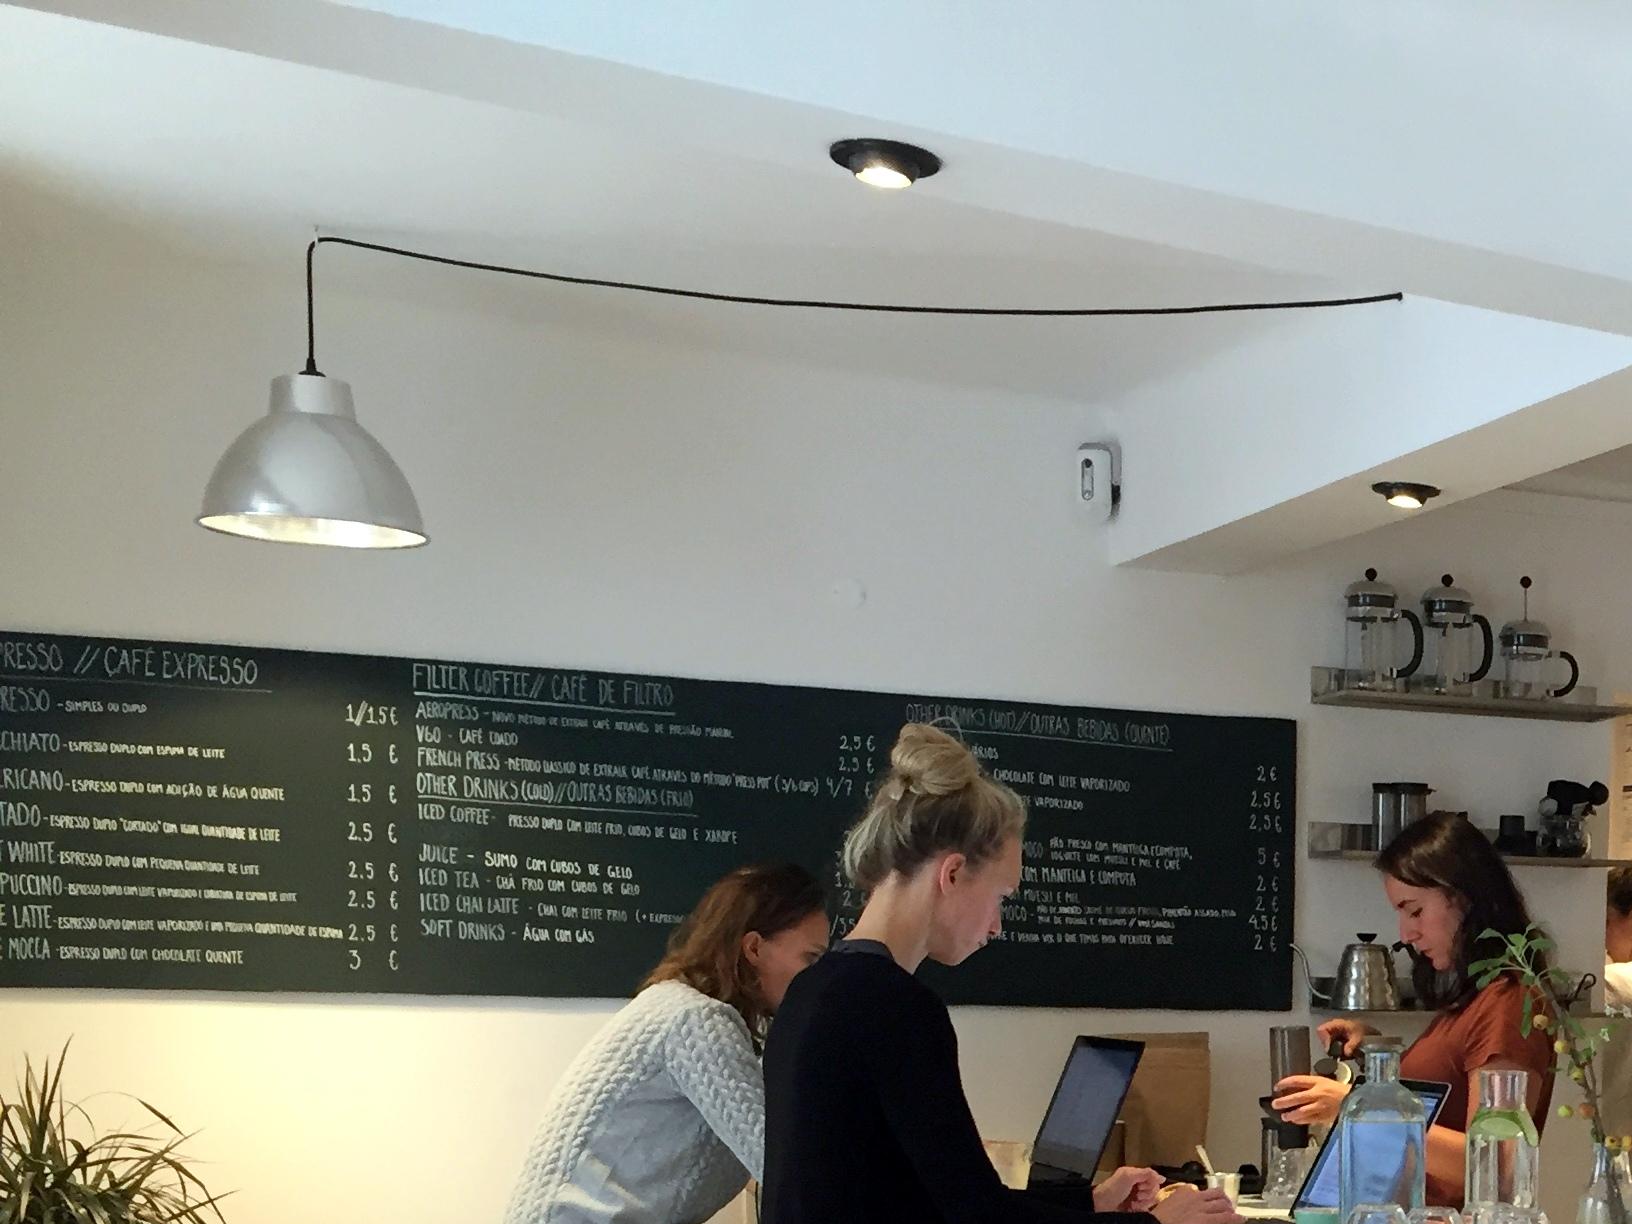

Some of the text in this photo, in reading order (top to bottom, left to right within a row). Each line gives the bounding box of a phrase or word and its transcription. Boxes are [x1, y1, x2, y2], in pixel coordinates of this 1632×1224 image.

[0, 641, 258, 685] RESSO CAFÉ EXPRESSO
[412, 663, 470, 692] FILTER
[551, 674, 587, 702] CAFÉ
[599, 679, 615, 705] DE
[623, 680, 674, 707] FILTRO
[122, 704, 148, 713] DUPLO
[415, 701, 479, 720] AEROPRESS
[416, 724, 441, 743] V60
[459, 728, 483, 744] CAFÉ
[188, 747, 199, 757] DE
[203, 748, 226, 759] LEITE
[418, 747, 461, 767] FRENCH
[466, 750, 500, 770] PRESS
[579, 762, 590, 775] DE
[0, 768, 63, 792] RICANO
[147, 782, 163, 794] COM
[207, 785, 218, 798] DE
[222, 784, 248, 799] ÁGUA
[251, 787, 285, 800] QUENTE
[993, 768, 1034, 785] CHOCOLATE
[1257, 765, 1266, 782] 2
[416, 772, 458, 797] OTHER
[463, 775, 519, 800] DRINKS
[418, 803, 445, 820] ICED
[348, 821, 373, 841] 2.5
[7, 841, 56, 864] WHITE
[227, 862, 238, 874] DE
[418, 843, 633, 880] JUICE SUMO COM CUBOS DE GELO
[348, 861, 374, 880] 2.5
[418, 867, 448, 886] ICED
[454, 870, 480, 889] TEA
[496, 873, 515, 890] CHÁ
[521, 877, 544, 891] FRIO
[548, 879, 565, 892] COM
[571, 880, 598, 894] CUBOS
[602, 882, 613, 895] DE
[1256, 874, 1266, 891] 2
[348, 889, 375, 909] 2.5
[419, 893, 449, 912] ICED
[455, 895, 484, 914] CHAI
[562, 905, 578, 918] COM
[12, 904, 53, 929] LATTE
[348, 923, 375, 942] 2.5
[420, 918, 595, 943] SOFT DRINKS ÁGUA COM GÁS
[8, 936, 51, 960] MOCCA
[130, 947, 148, 960] COM
[205, 950, 244, 964] QUENTE
